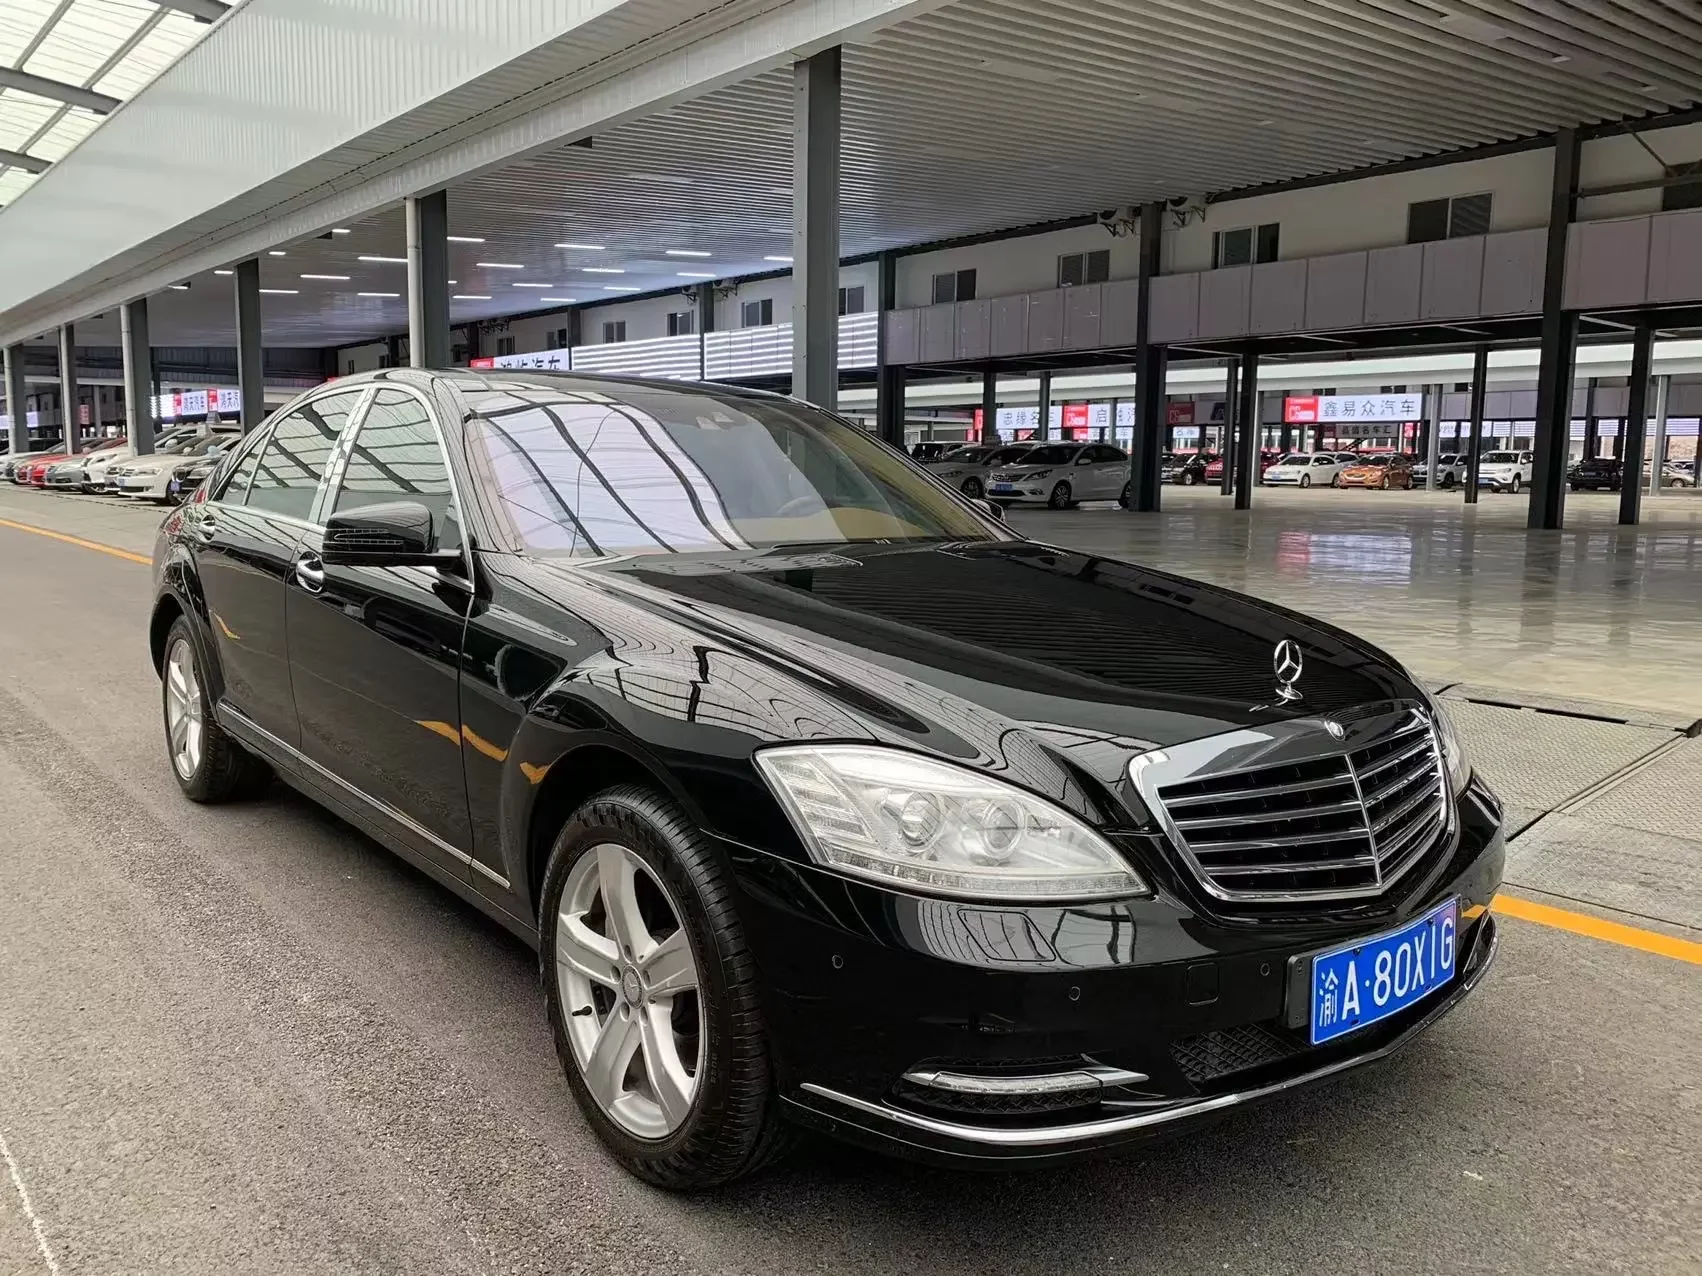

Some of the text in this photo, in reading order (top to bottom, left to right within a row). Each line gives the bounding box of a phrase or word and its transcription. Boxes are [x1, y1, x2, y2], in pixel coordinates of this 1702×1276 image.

[1323, 400, 1415, 417] 鑫易众汽车
